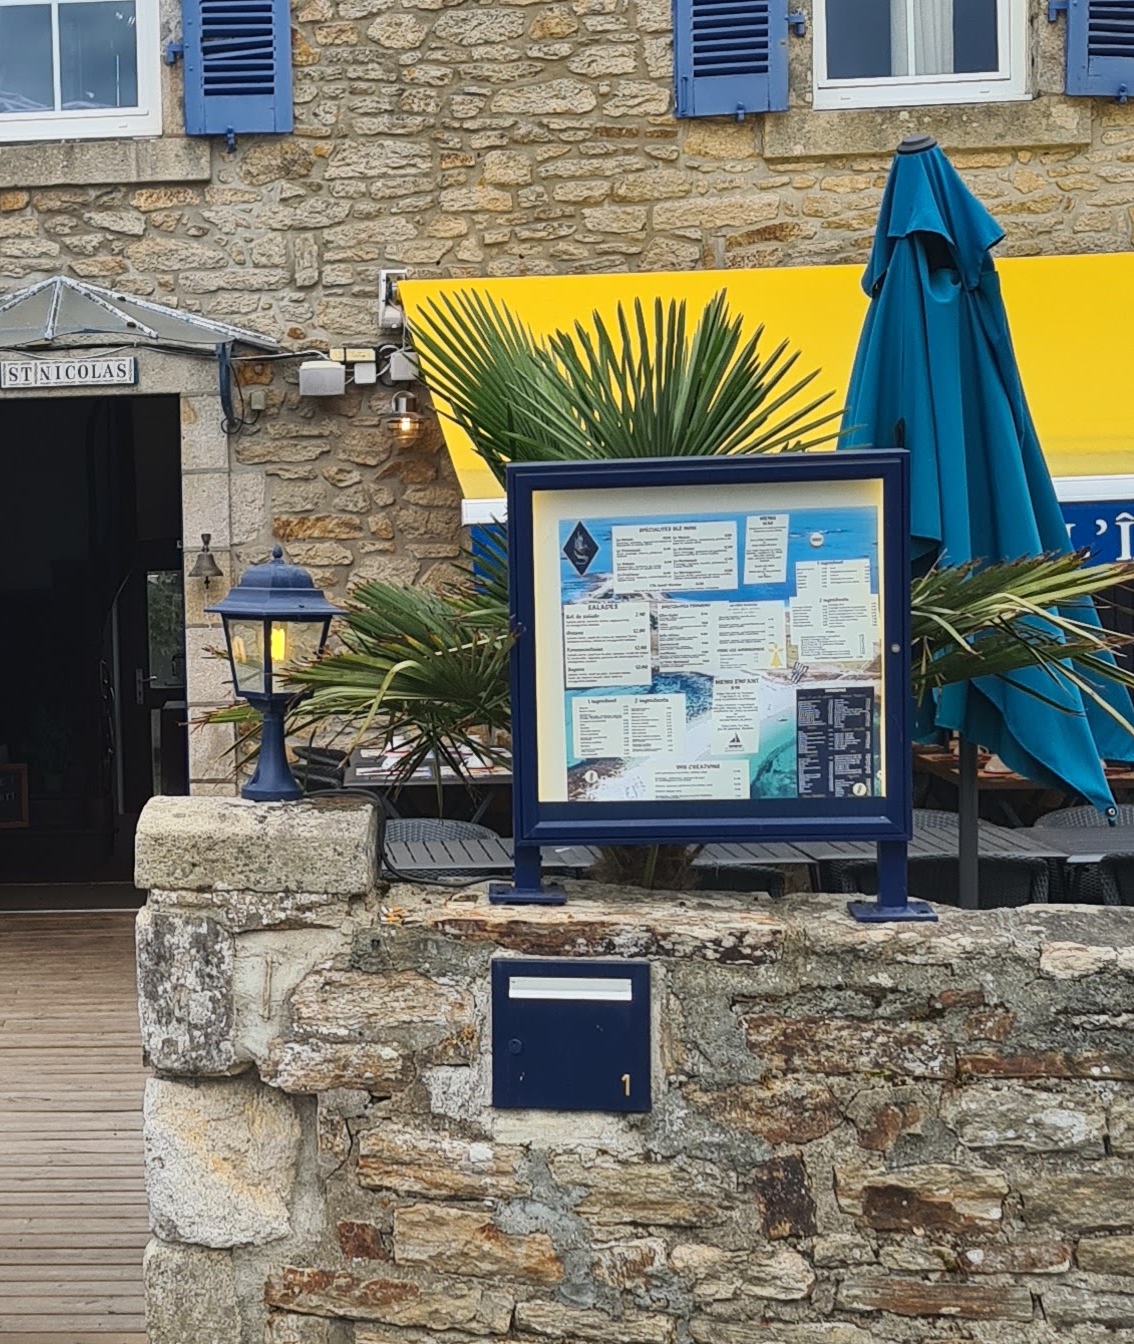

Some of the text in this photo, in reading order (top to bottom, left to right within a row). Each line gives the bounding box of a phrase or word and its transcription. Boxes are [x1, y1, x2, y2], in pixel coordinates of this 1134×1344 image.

[8, 363, 128, 382] ST NICOLAS
[621, 1073, 631, 1097] 1
